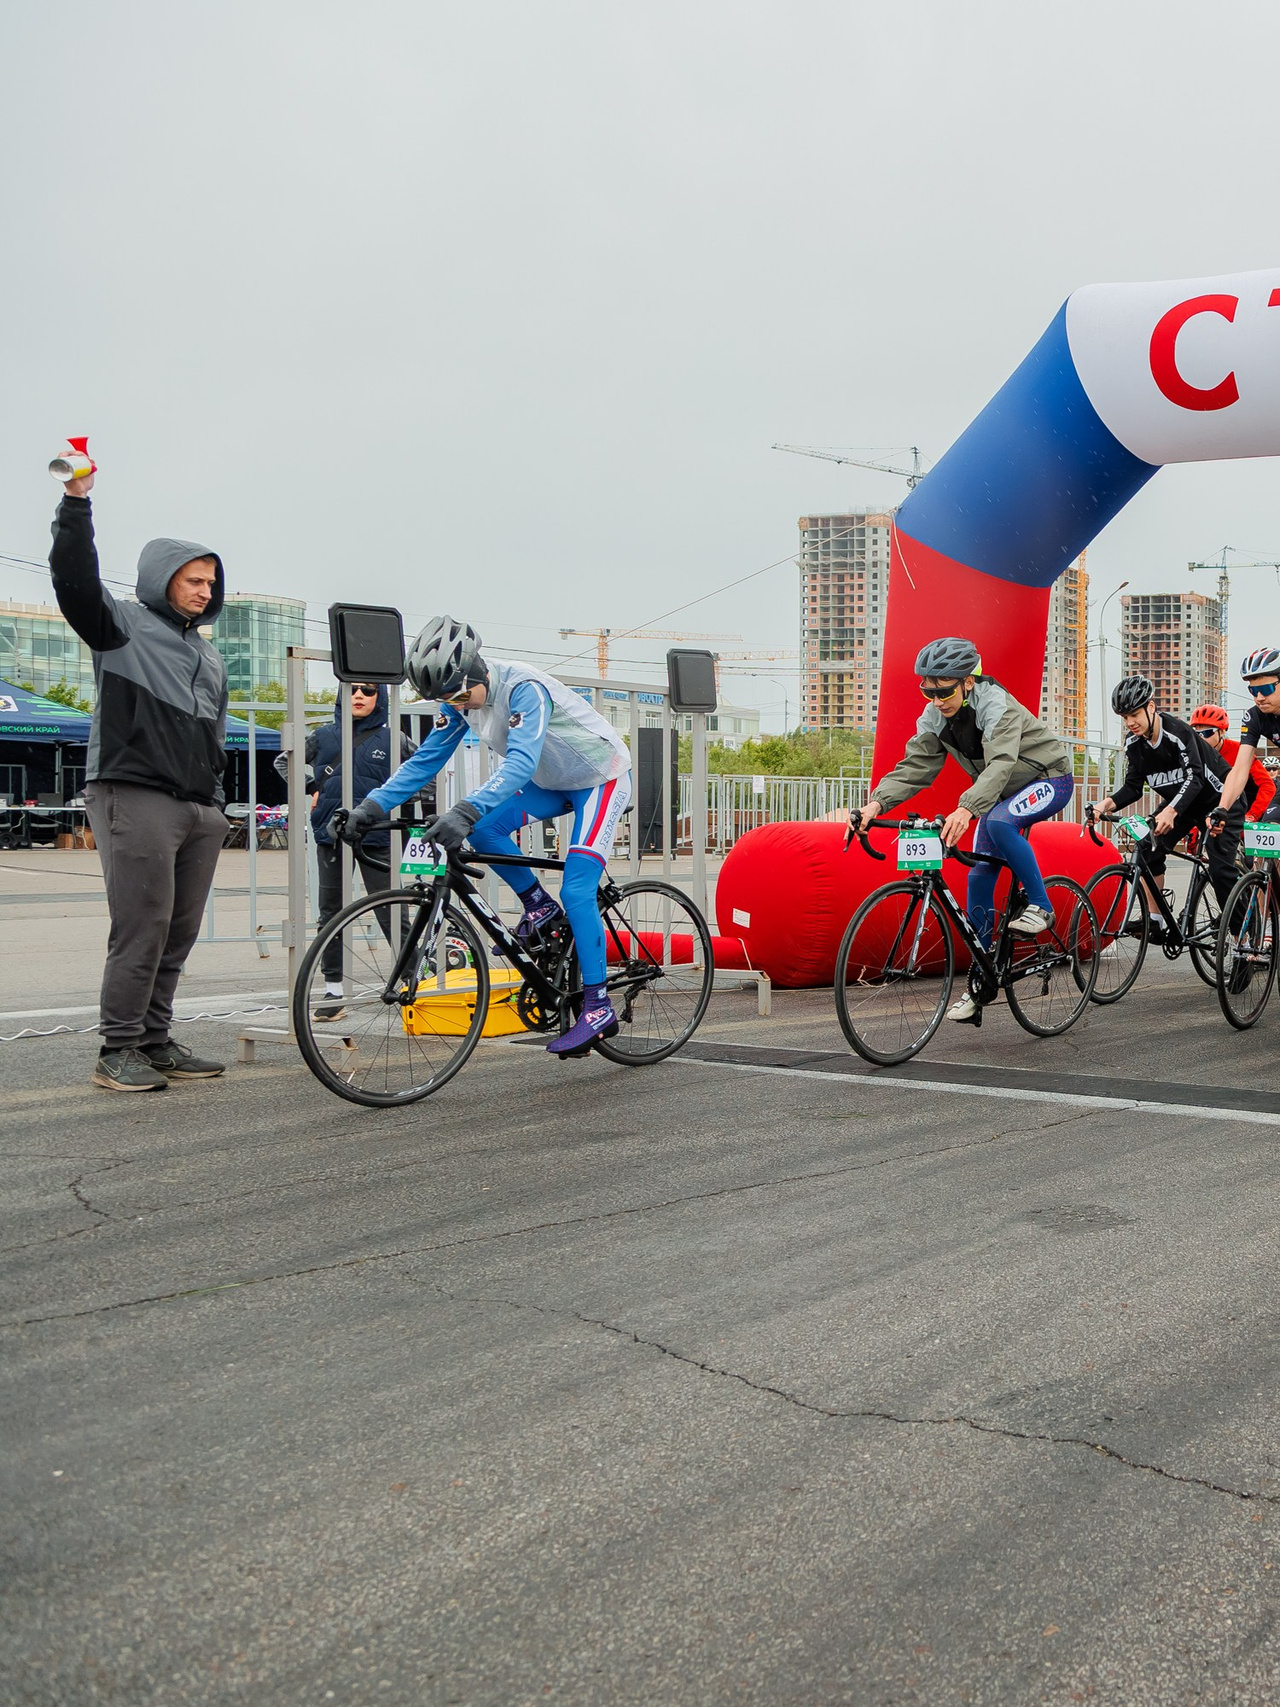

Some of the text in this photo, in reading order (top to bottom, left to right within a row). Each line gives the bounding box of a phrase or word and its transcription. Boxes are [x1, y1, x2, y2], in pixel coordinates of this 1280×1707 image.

[35, 725, 60, 733] КРАЙ
[1015, 784, 1052, 814] ITERA
[1255, 834, 1275, 847] 920
[905, 843, 927, 857] 893
[1025, 961, 1056, 975] BXT
